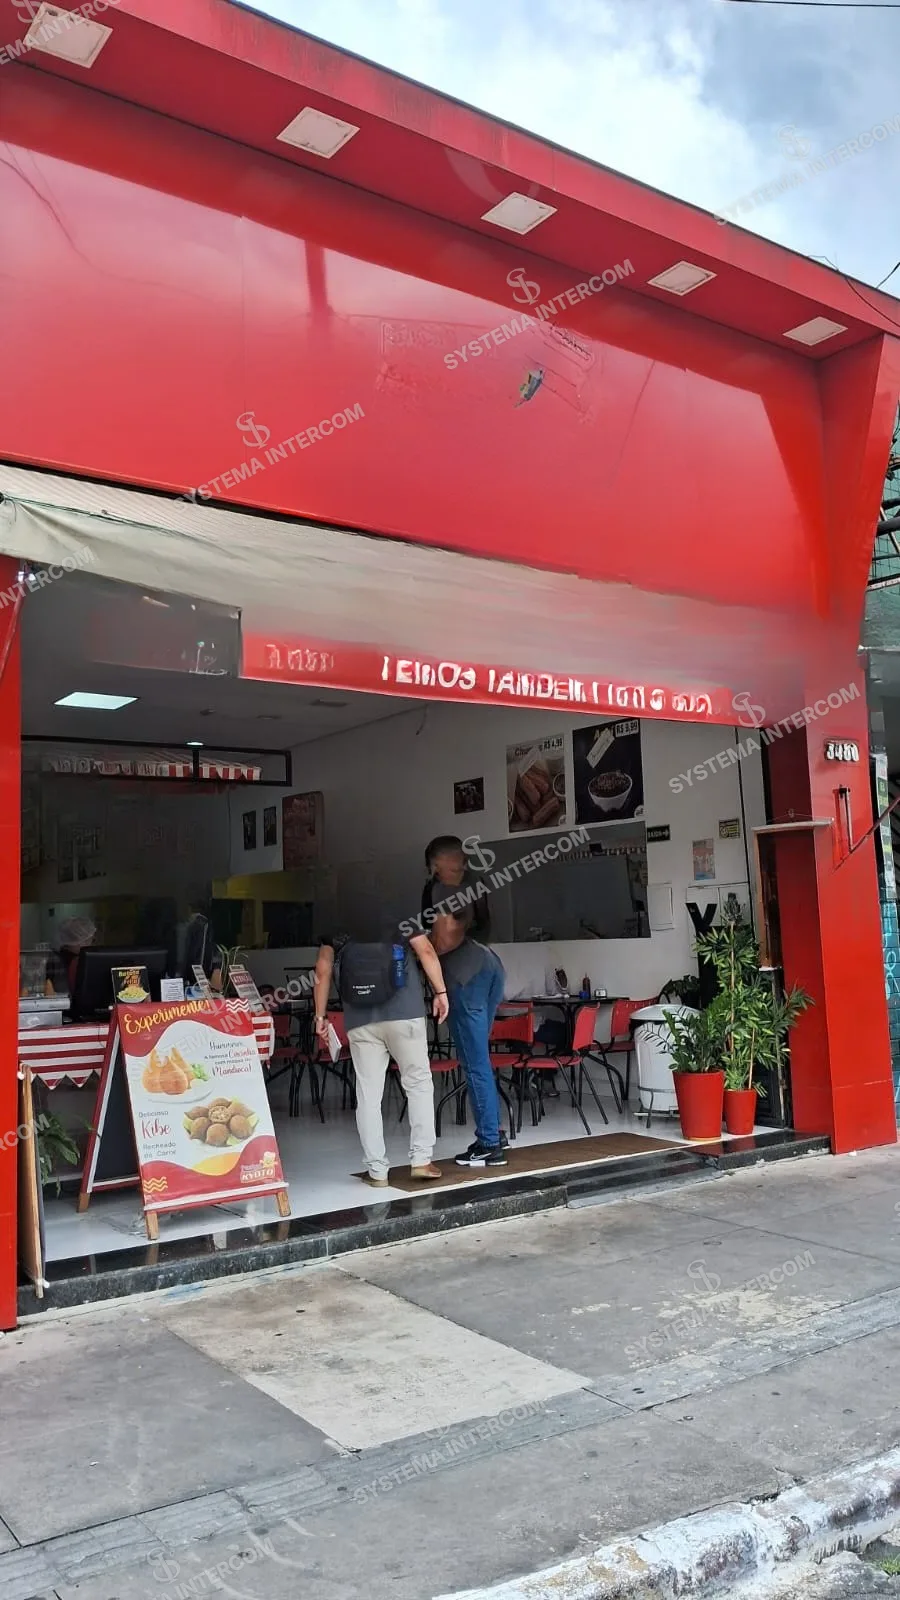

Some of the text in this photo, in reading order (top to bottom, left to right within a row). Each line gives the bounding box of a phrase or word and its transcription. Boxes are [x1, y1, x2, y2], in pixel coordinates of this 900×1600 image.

[124, 999, 210, 1034] Experimente!
[141, 1118, 171, 1139] Kibe
[242, 1168, 274, 1181] KYOTO
